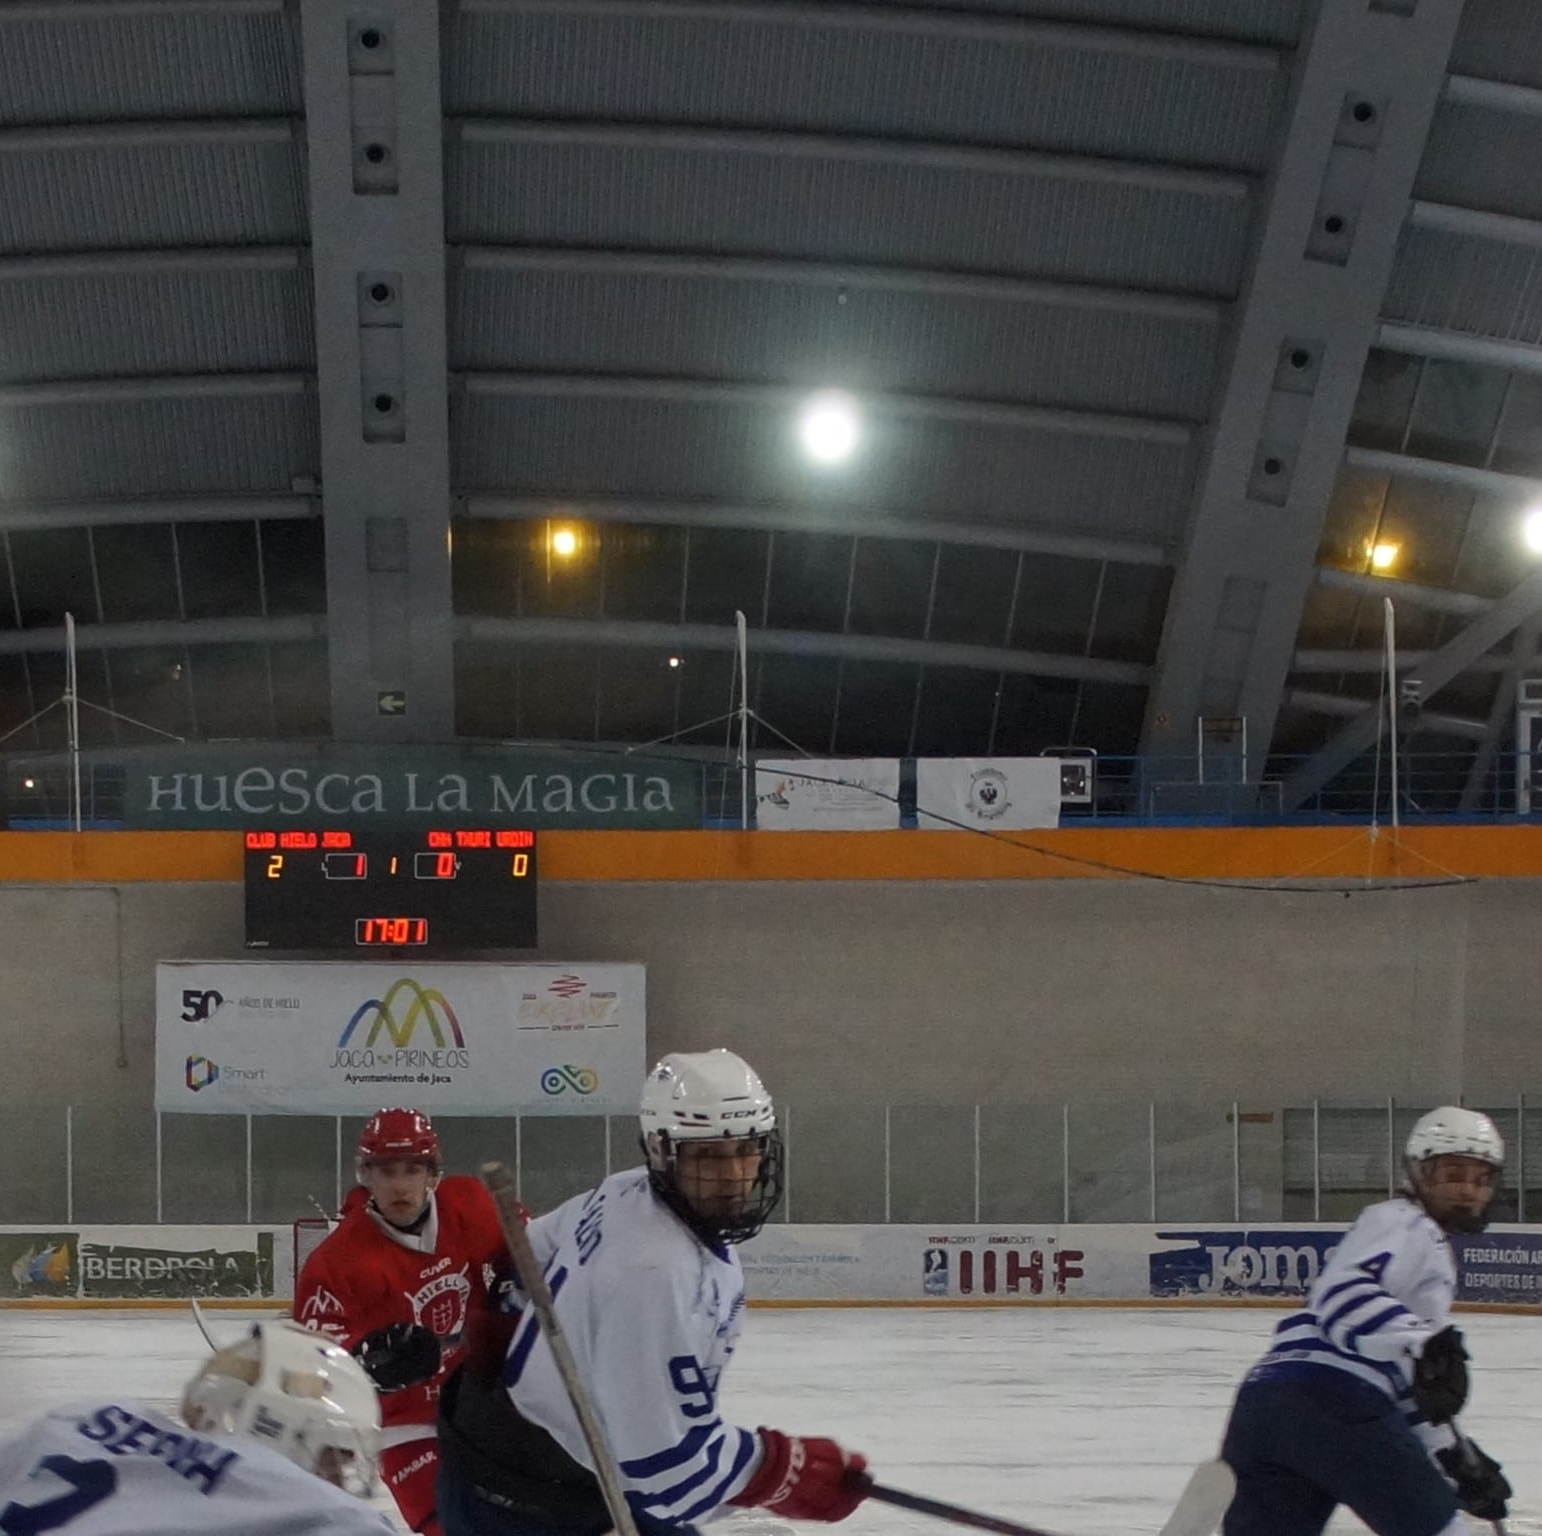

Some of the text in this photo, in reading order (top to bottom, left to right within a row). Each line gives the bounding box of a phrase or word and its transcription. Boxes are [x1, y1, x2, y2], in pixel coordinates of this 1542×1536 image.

[246, 833, 276, 848] CLUB
[268, 855, 283, 878] 2
[356, 855, 363, 876] 1
[391, 857, 397, 875] 1
[437, 853, 453, 876] 0
[513, 854, 528, 876] 0
[365, 919, 424, 943] 17:01
[181, 989, 223, 1022] 50
[395, 1049, 470, 1069] PIRINEOS
[344, 1073, 452, 1085] Ayuntamiento de Jaca
[721, 1109, 758, 1120] CCM
[1463, 1247, 1529, 1265] FEDERACIÓN
[959, 1250, 1085, 1295] IIHF
[1465, 1273, 1521, 1288] DEPORTES
[1522, 1275, 1535, 1288] DE
[668, 1355, 714, 1418] 9
